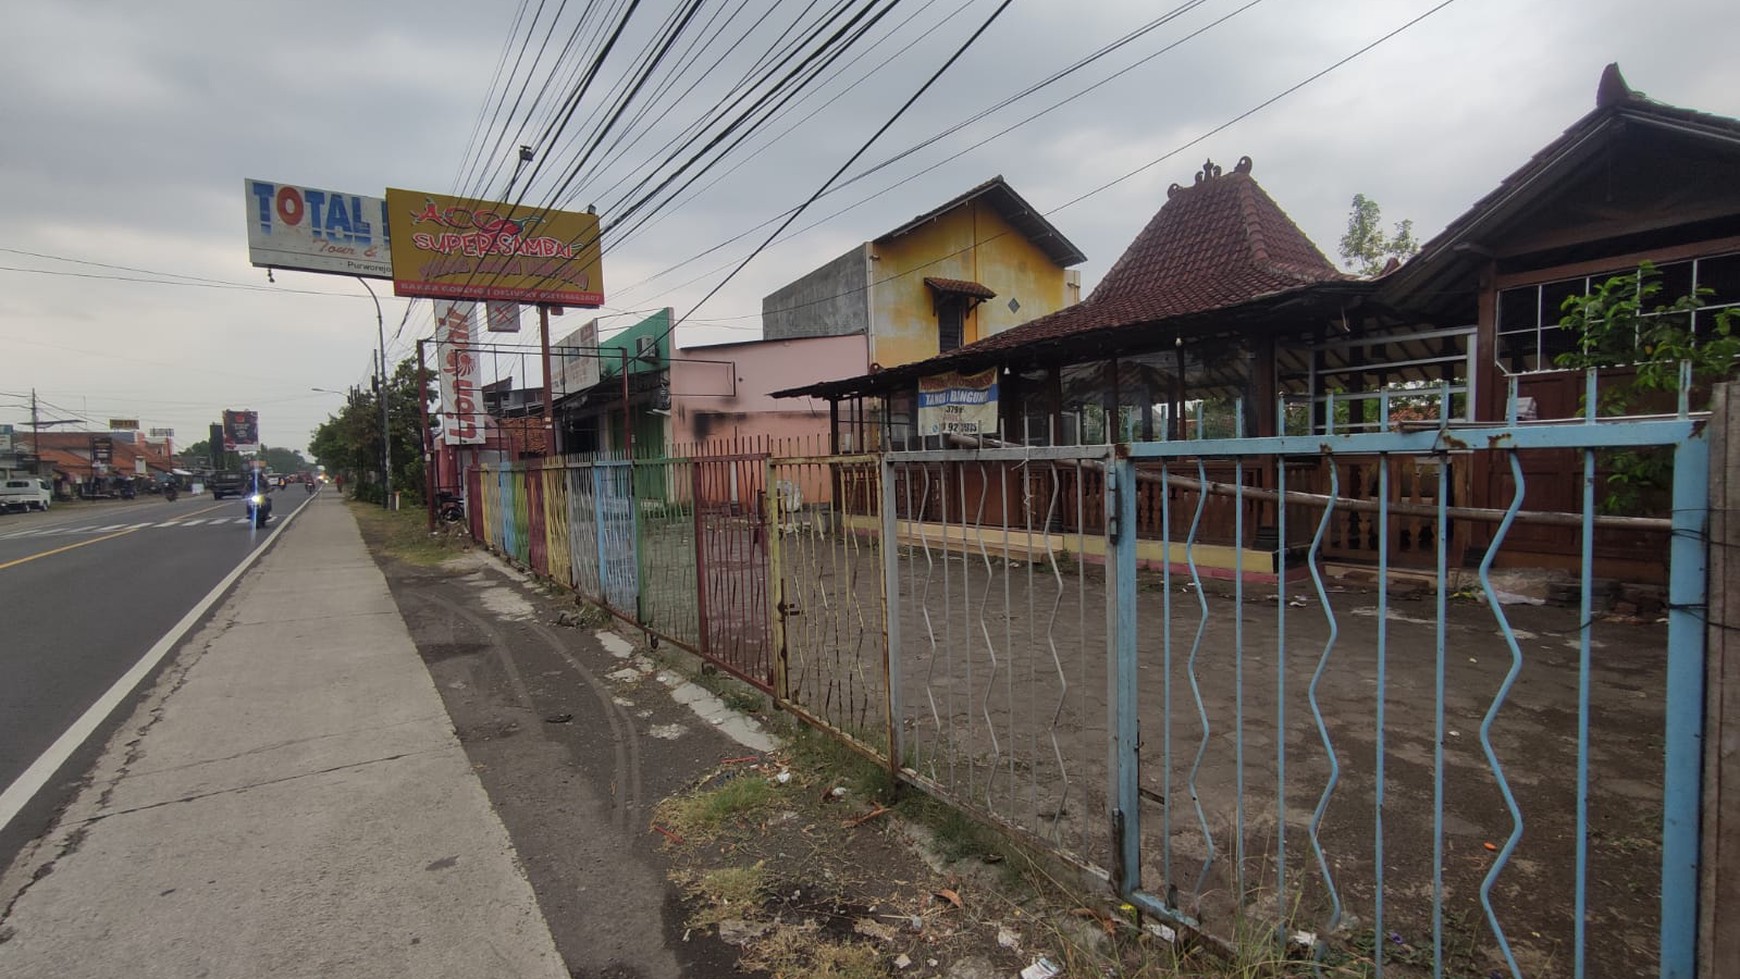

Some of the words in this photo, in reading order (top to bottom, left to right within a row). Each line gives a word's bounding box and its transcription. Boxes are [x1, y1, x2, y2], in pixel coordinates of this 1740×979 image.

[253, 182, 372, 243] TOTAL
[313, 238, 355, 255] Tour
[413, 232, 495, 257] SUPER
[498, 233, 581, 260] SAMBAL
[347, 260, 392, 274] Purworejo
[494, 289, 537, 300] DELIVERY
[445, 379, 477, 440] Lion
